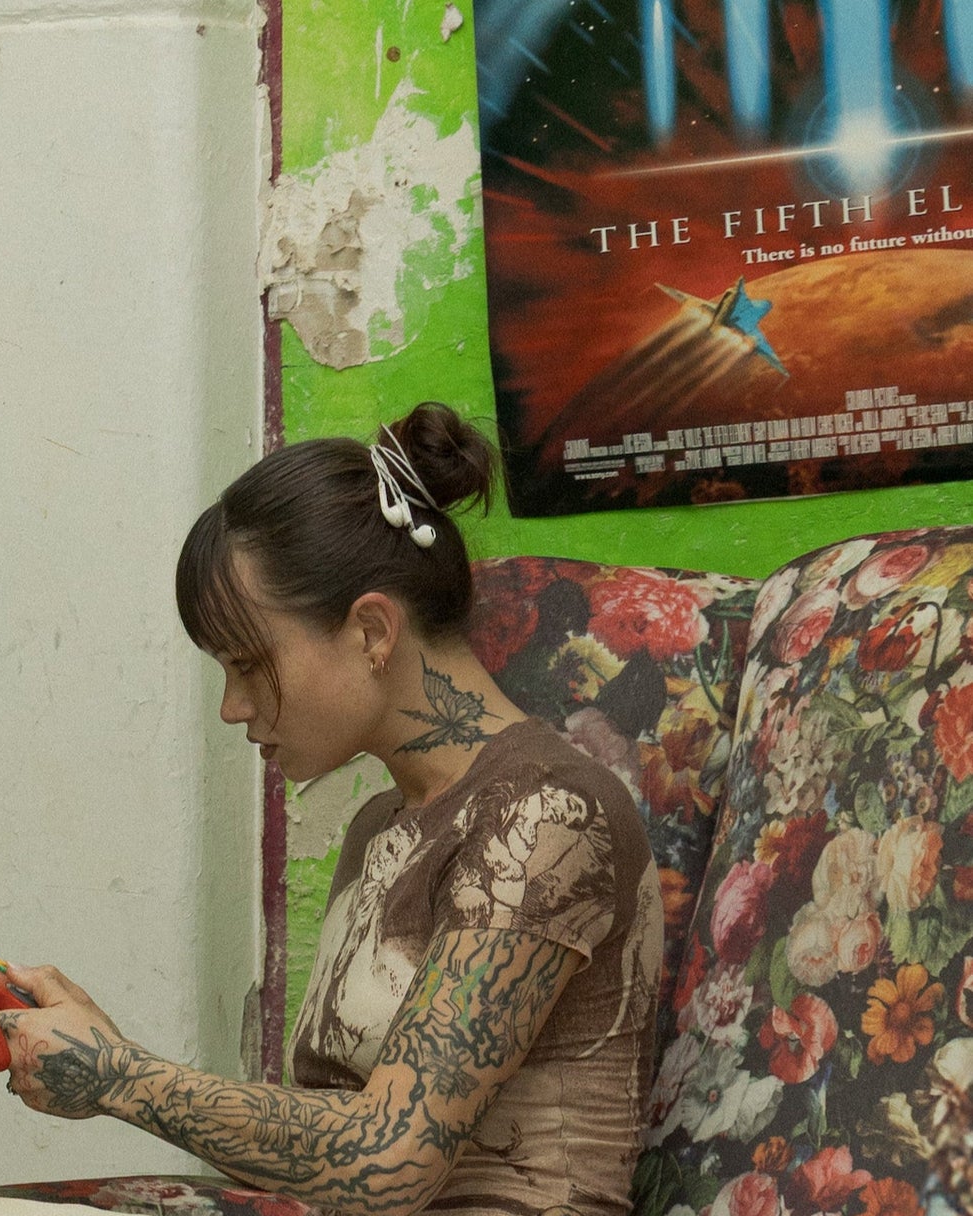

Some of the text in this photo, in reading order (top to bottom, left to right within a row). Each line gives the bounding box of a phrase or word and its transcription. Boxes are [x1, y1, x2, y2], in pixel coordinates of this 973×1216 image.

[589, 185, 963, 253] THE FIFTH EL
[741, 225, 973, 265] There is no future withou
